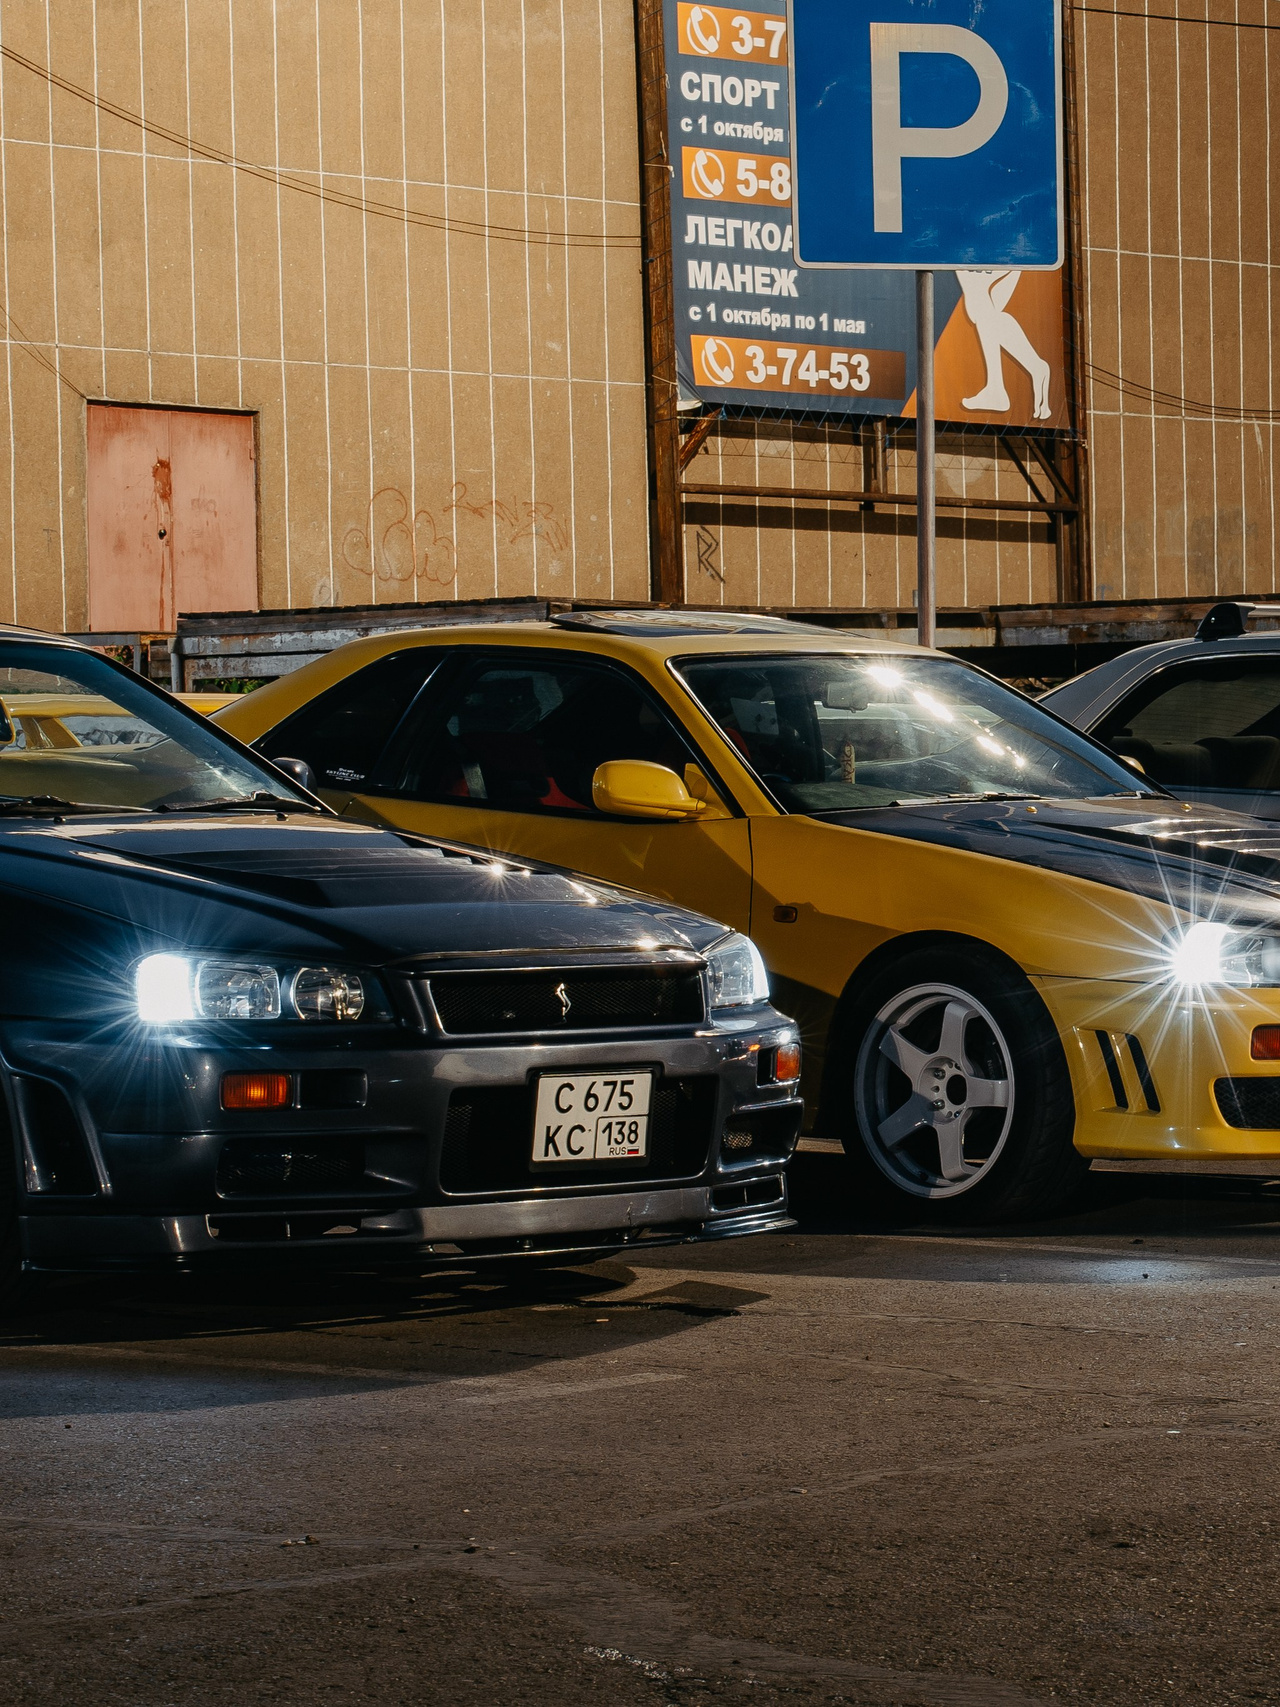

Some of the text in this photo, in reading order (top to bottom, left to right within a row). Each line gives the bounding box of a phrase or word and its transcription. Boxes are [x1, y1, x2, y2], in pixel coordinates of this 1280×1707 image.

[731, 15, 787, 58] 3-7
[680, 71, 780, 110] СПОРТ
[680, 115, 784, 145] с 1 октября
[870, 22, 1009, 233] P
[736, 158, 792, 201] 5-8
[687, 259, 799, 298] МАНЕЖ
[688, 303, 866, 335] с 1 октября по 1 мая
[744, 345, 871, 392] 3-74-53
[555, 1079, 634, 1114] С 675
[543, 1120, 639, 1157] КС 138
[609, 1147, 627, 1156] RUS
